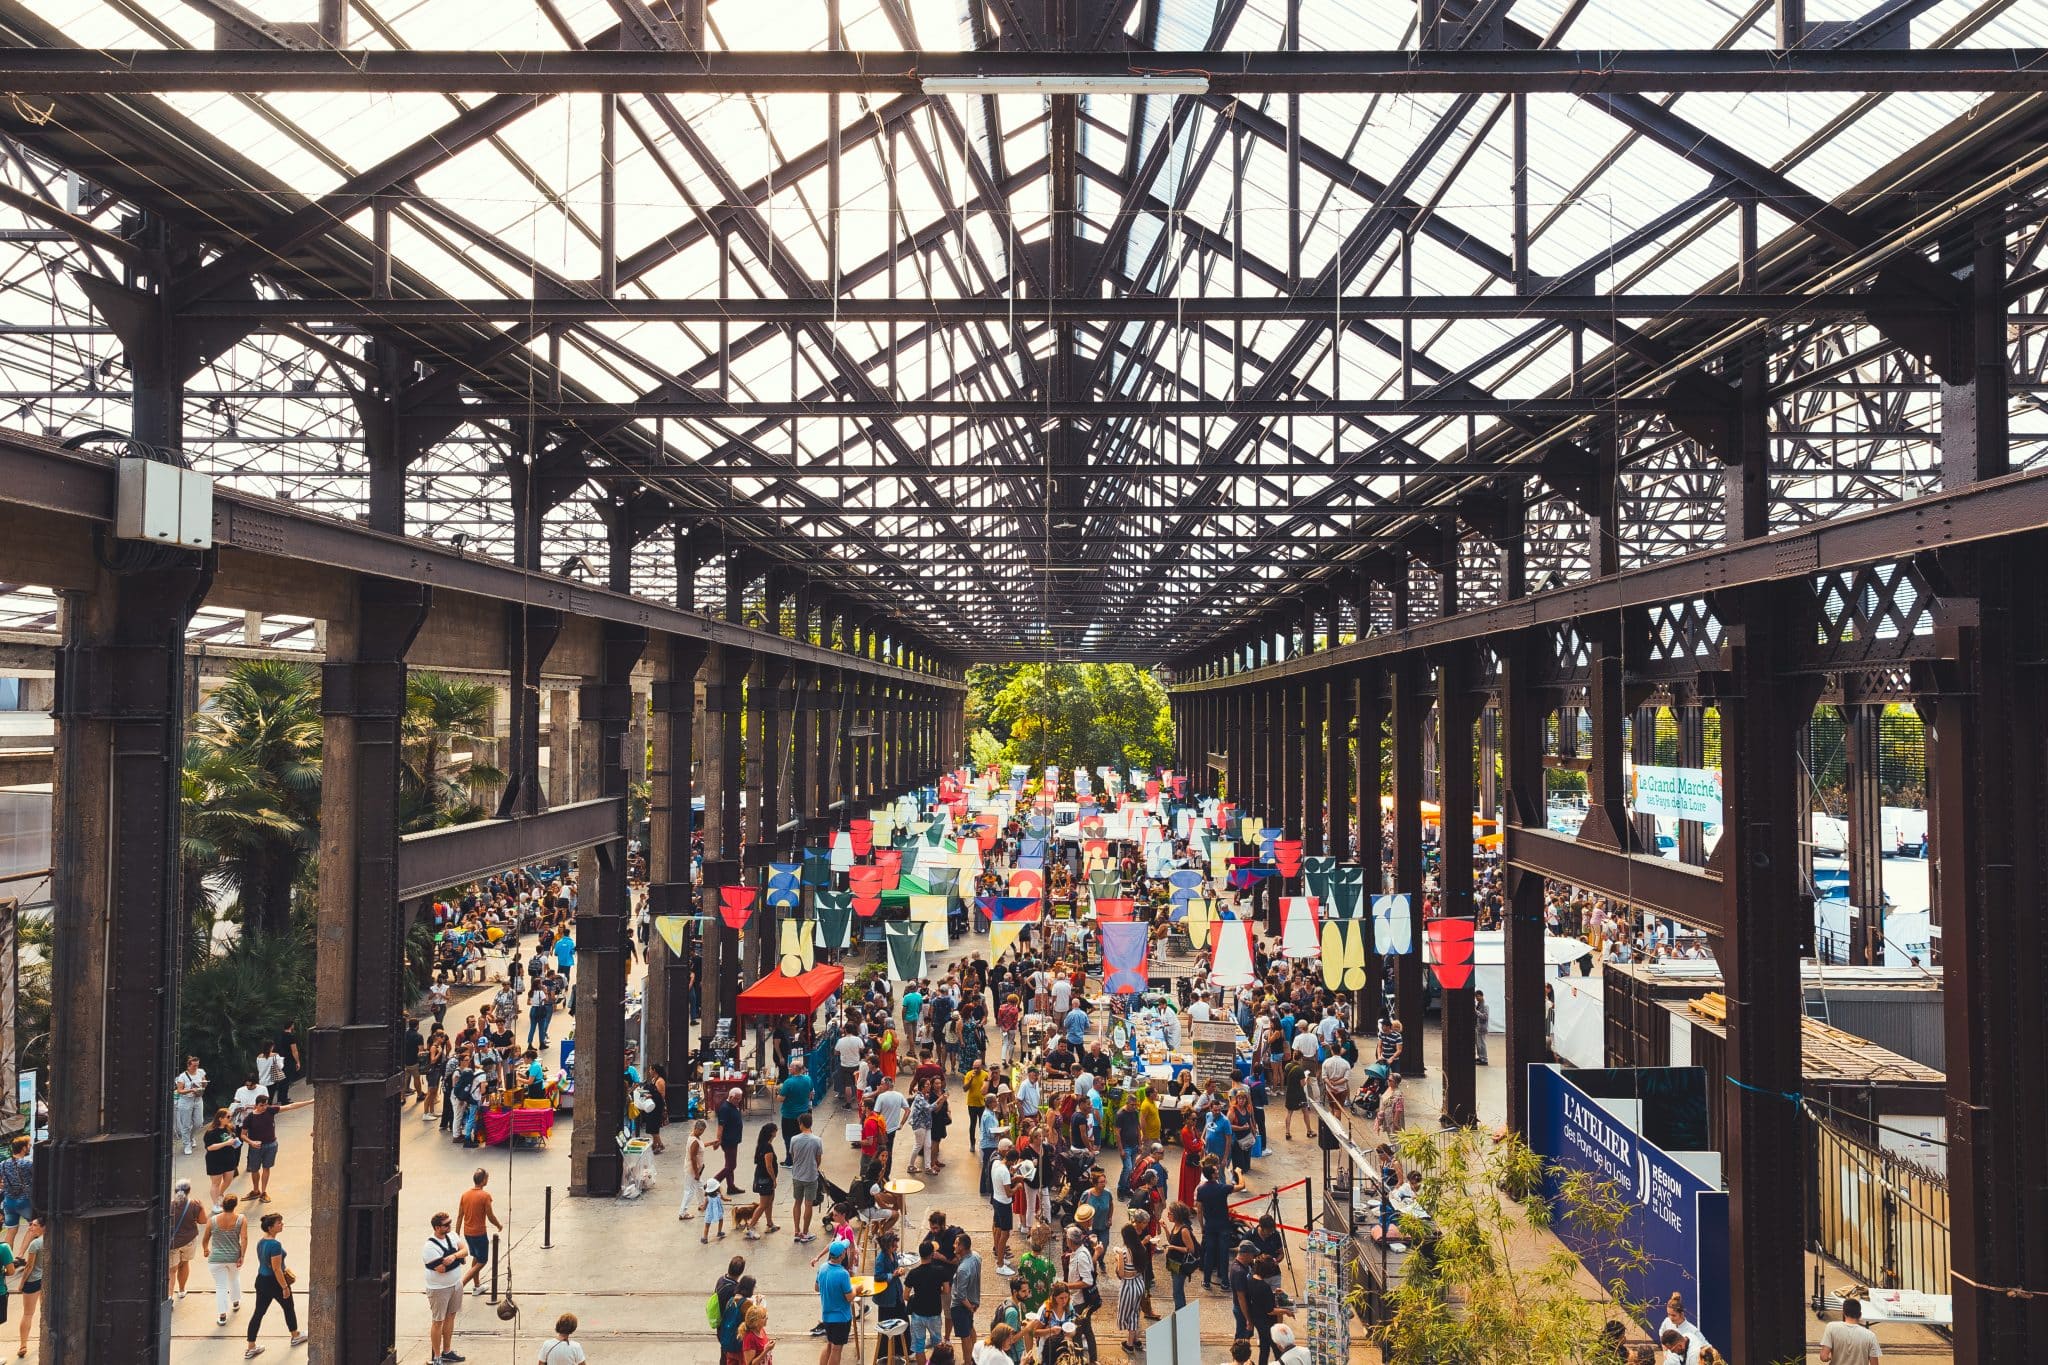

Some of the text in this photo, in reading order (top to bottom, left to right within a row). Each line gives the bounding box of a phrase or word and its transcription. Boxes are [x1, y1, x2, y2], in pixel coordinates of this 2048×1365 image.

[1638, 775, 1715, 798] Le Grand Marché
[1656, 794, 1671, 809] Pays
[1672, 797, 1680, 808] de
[1681, 797, 1688, 809] la
[1689, 798, 1707, 812] Loire
[1564, 1092, 1632, 1168] L'ATELIER
[1564, 1123, 1632, 1191] des Pays de la Loire
[1652, 1164, 1682, 1199] RÉGION
[1652, 1181, 1672, 1208] PAYS
[1660, 1202, 1682, 1234] LOIRE
